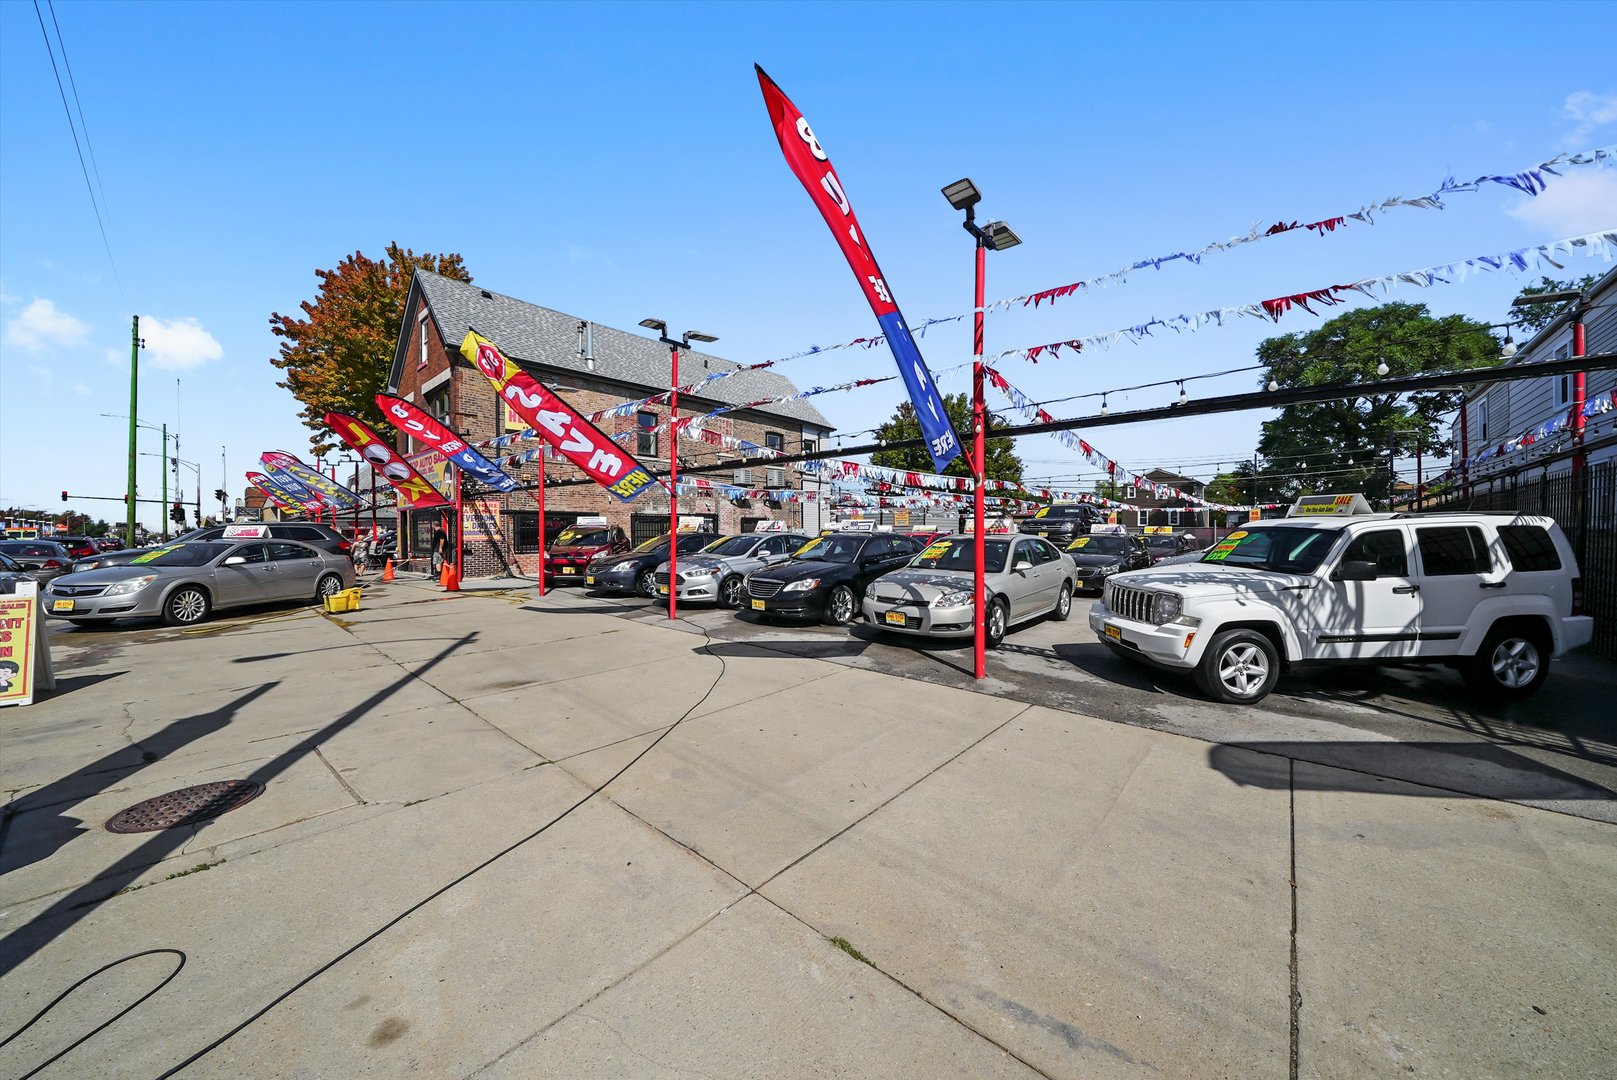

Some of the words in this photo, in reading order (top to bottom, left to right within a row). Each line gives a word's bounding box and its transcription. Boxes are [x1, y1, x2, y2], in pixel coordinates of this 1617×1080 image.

[420, 455, 432, 469] AUTO
[433, 452, 447, 464] SAL
[1335, 495, 1353, 506] SALE
